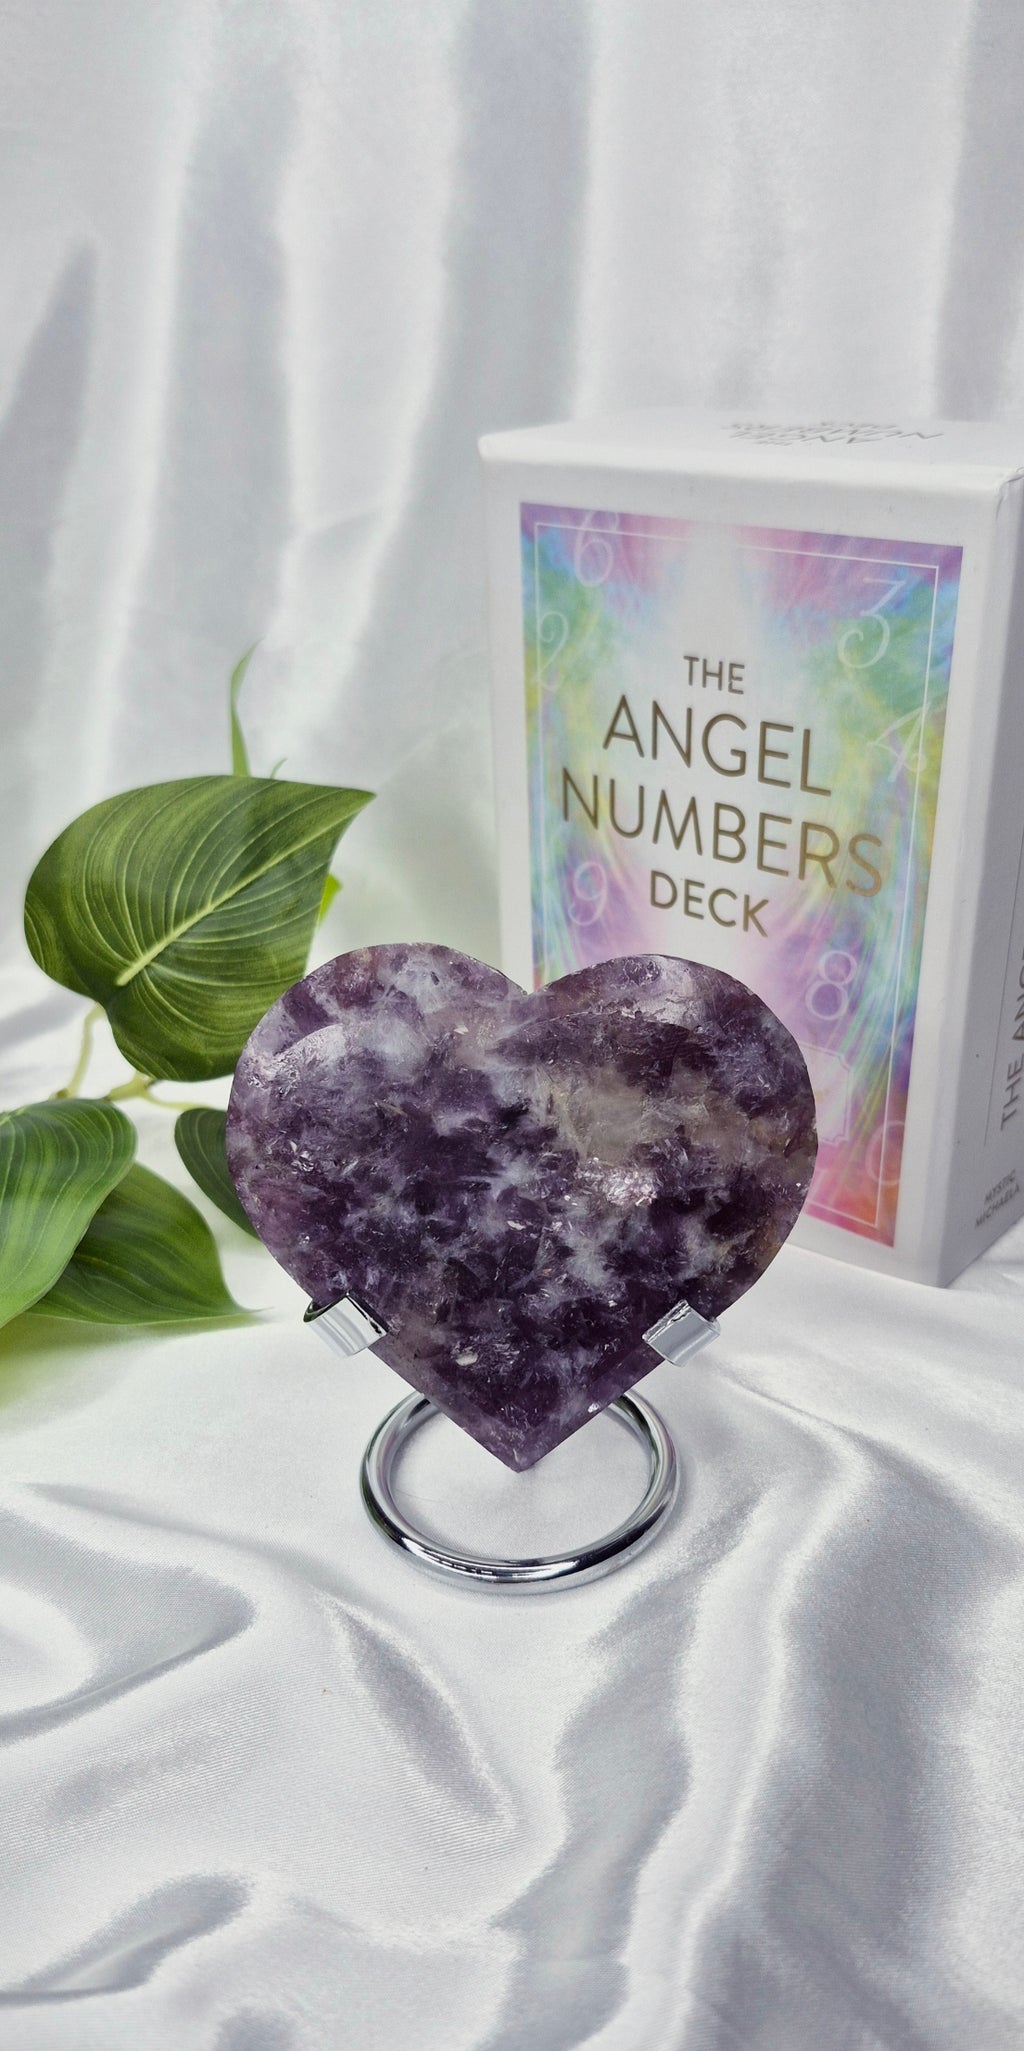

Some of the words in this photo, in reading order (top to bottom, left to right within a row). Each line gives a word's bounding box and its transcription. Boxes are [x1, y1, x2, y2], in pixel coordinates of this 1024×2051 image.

[838, 577, 906, 669] 3
[683, 655, 745, 695] THE
[602, 694, 831, 797] ANGEL
[562, 767, 883, 897] NUMBERS
[568, 861, 608, 926] 9
[650, 870, 769, 938] DECK
[805, 950, 857, 1020] 8
